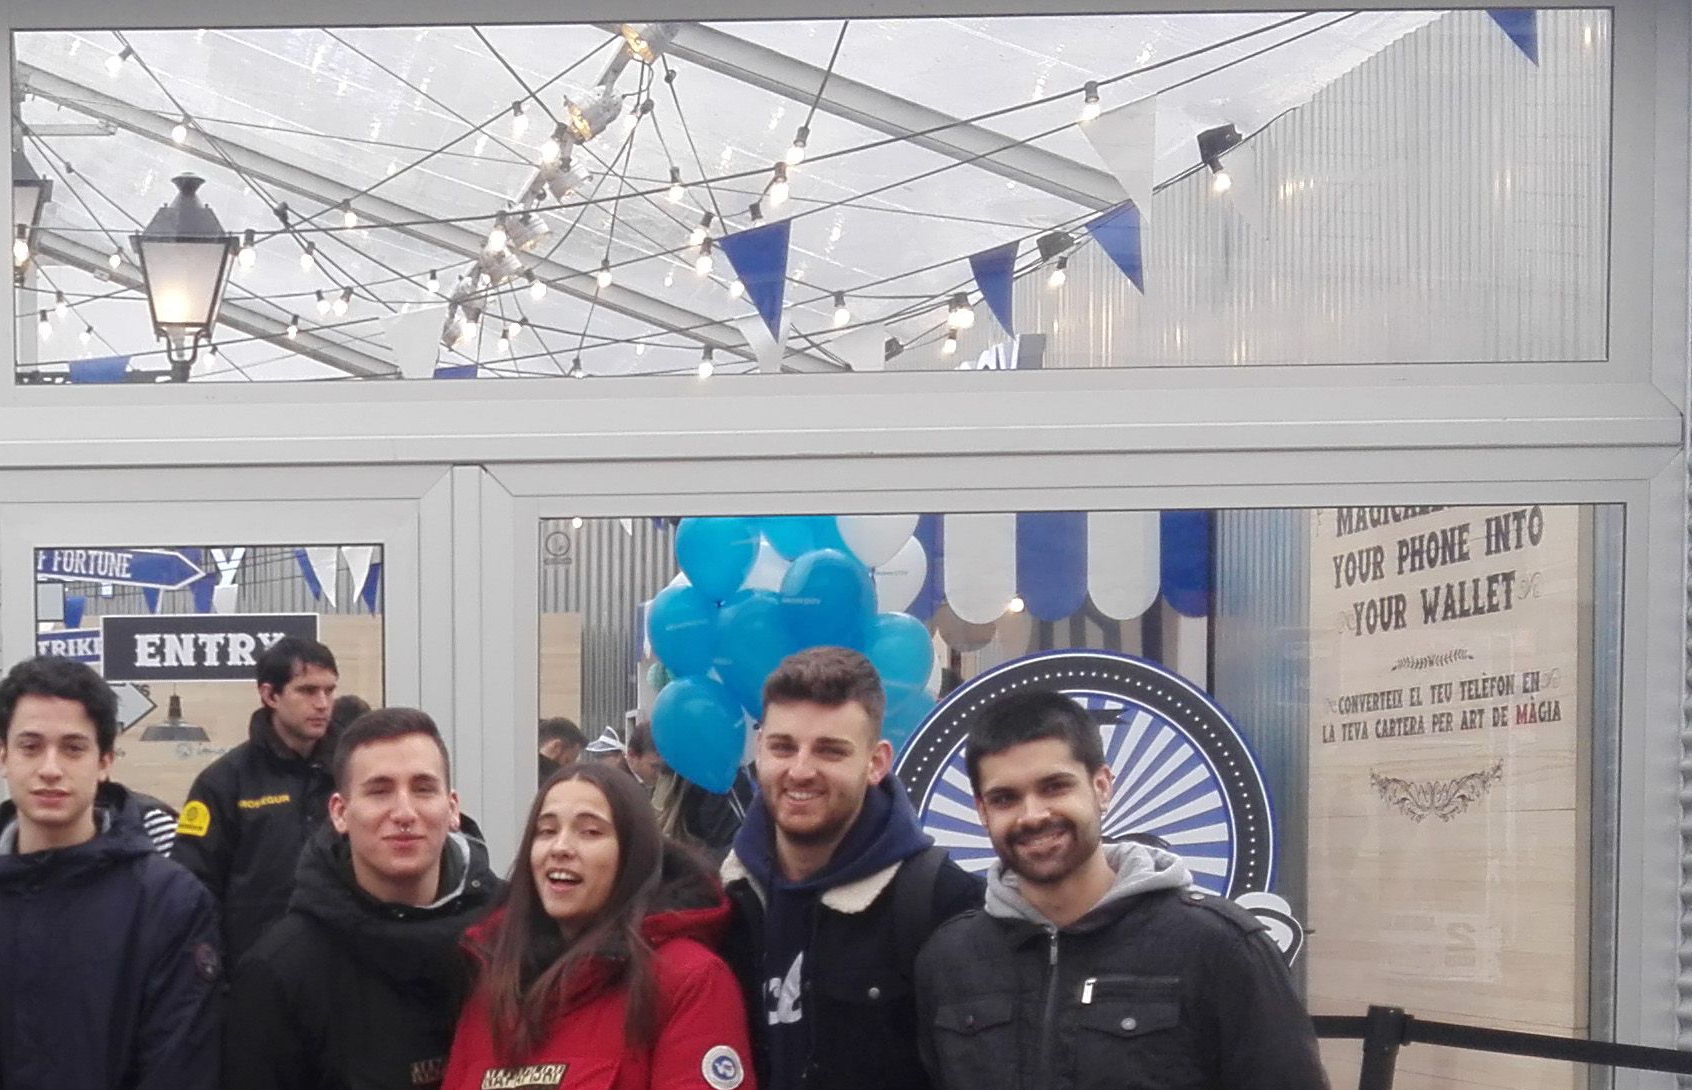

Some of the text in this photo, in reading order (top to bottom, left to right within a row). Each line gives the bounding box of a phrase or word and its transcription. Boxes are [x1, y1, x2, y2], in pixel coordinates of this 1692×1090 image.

[52, 550, 133, 578] FORTUNE
[1333, 505, 1543, 589] YOUR PHONE INTO
[1353, 570, 1516, 636] YOUR WALLET
[1338, 688, 1403, 714] CONVERTEIX
[1409, 686, 1423, 707] EL
[1430, 682, 1453, 705] TEU
[1522, 671, 1540, 693] EN
[1322, 724, 1336, 743] LA
[1342, 721, 1369, 741] TEVA
[1375, 715, 1425, 738] CARTERA
[1432, 712, 1453, 732] PER
[1460, 708, 1485, 730] ART
[1492, 706, 1508, 726] DE
